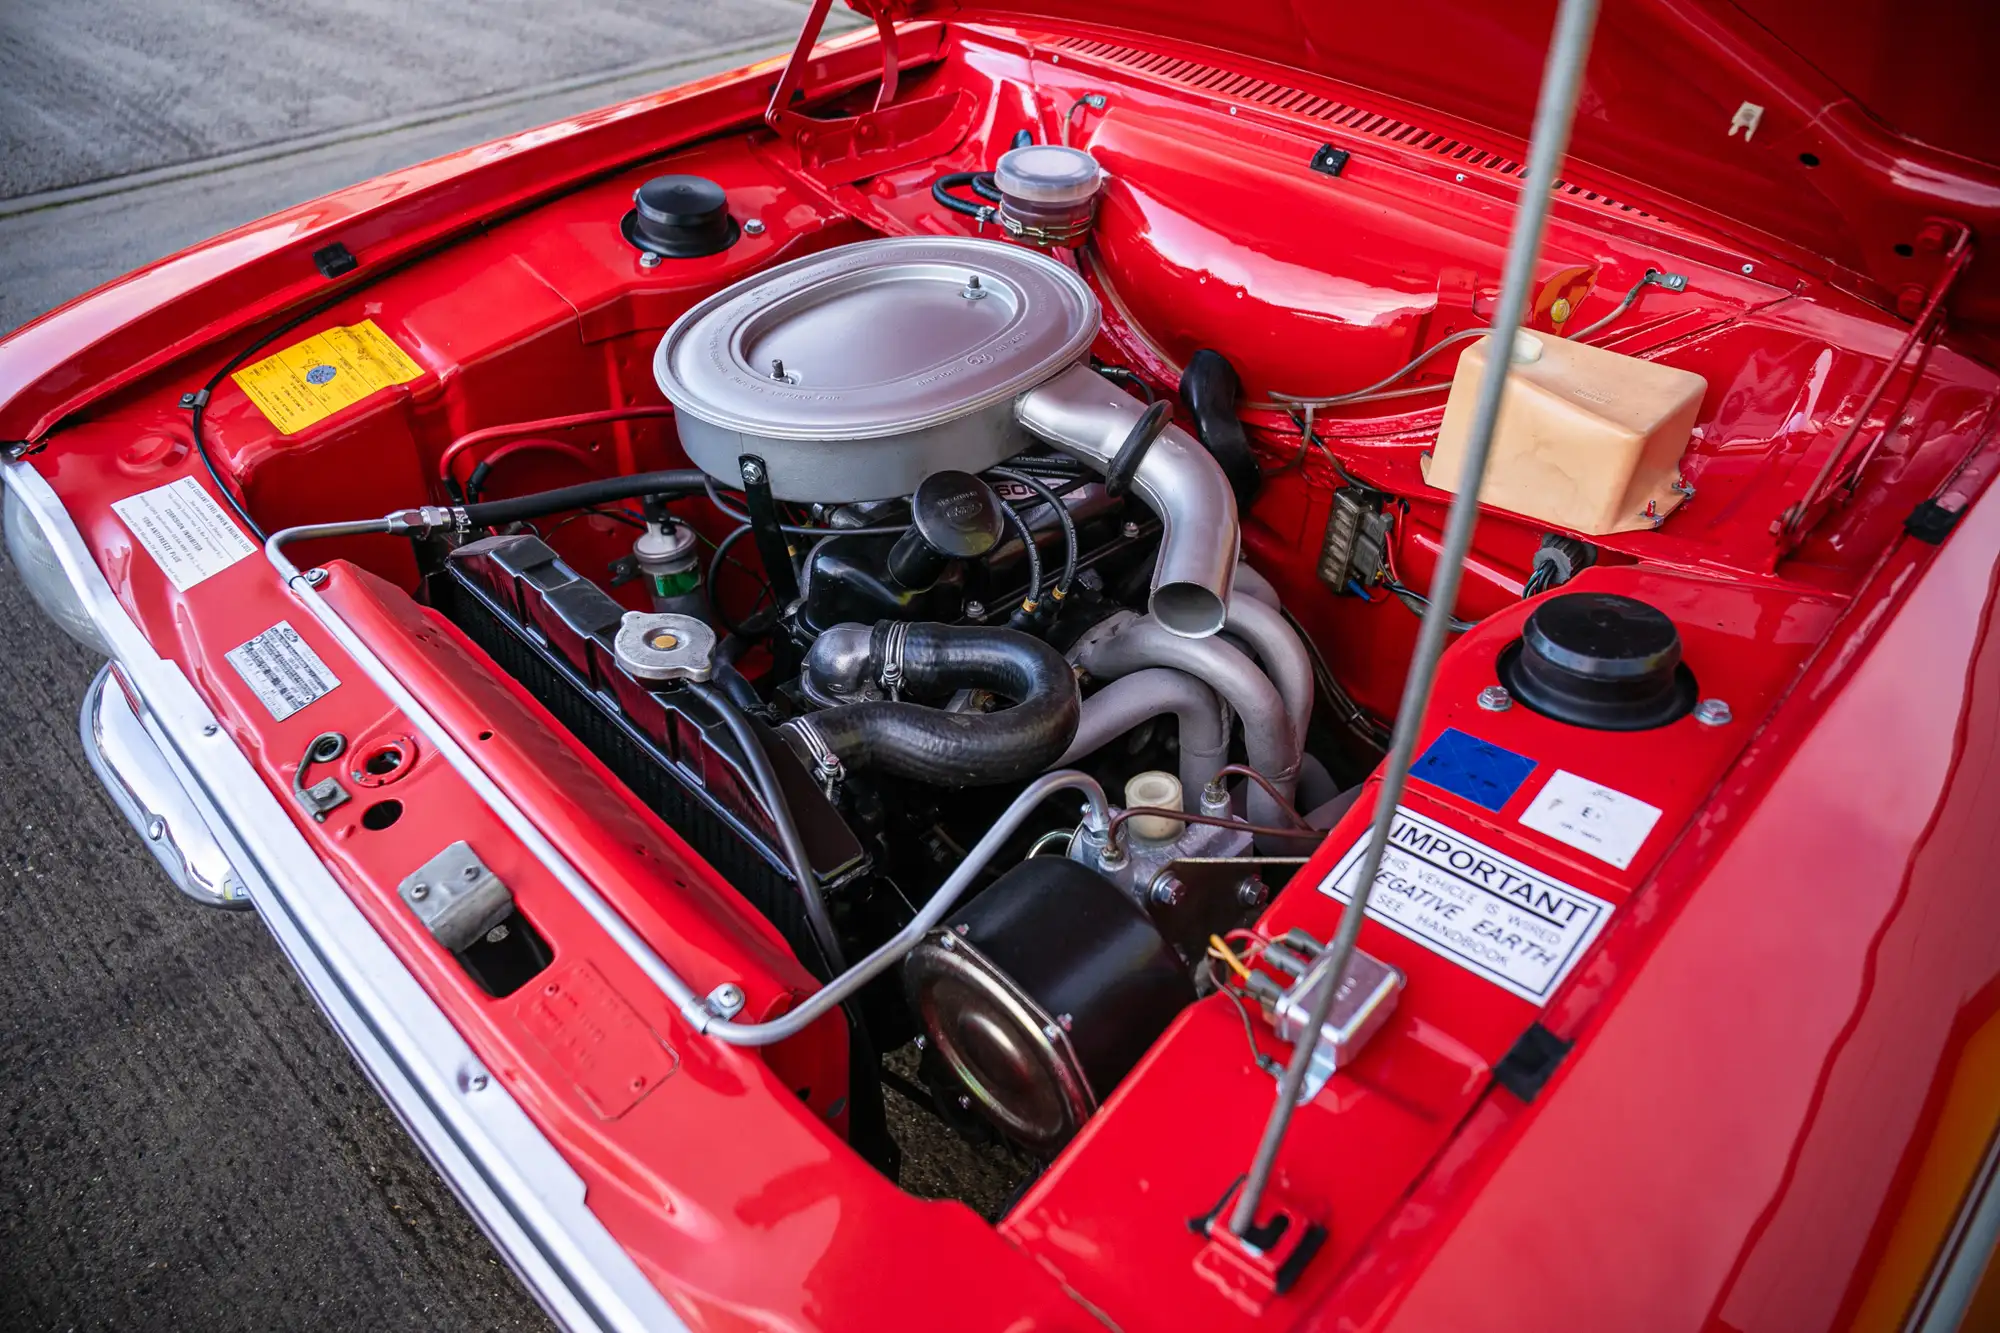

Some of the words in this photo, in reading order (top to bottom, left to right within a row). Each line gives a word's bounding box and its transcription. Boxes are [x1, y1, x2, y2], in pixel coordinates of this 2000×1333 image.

[1391, 822, 1588, 923] IMPORTANT
[1417, 869, 1478, 905] VEHICLE
[1484, 902, 1500, 917] IS
[1507, 914, 1562, 945] WIRED
[1375, 868, 1464, 921] EGATIVE
[1472, 919, 1558, 967] EARTH
[1376, 894, 1405, 914] SEE
[1417, 913, 1508, 966] HANDBOOK
